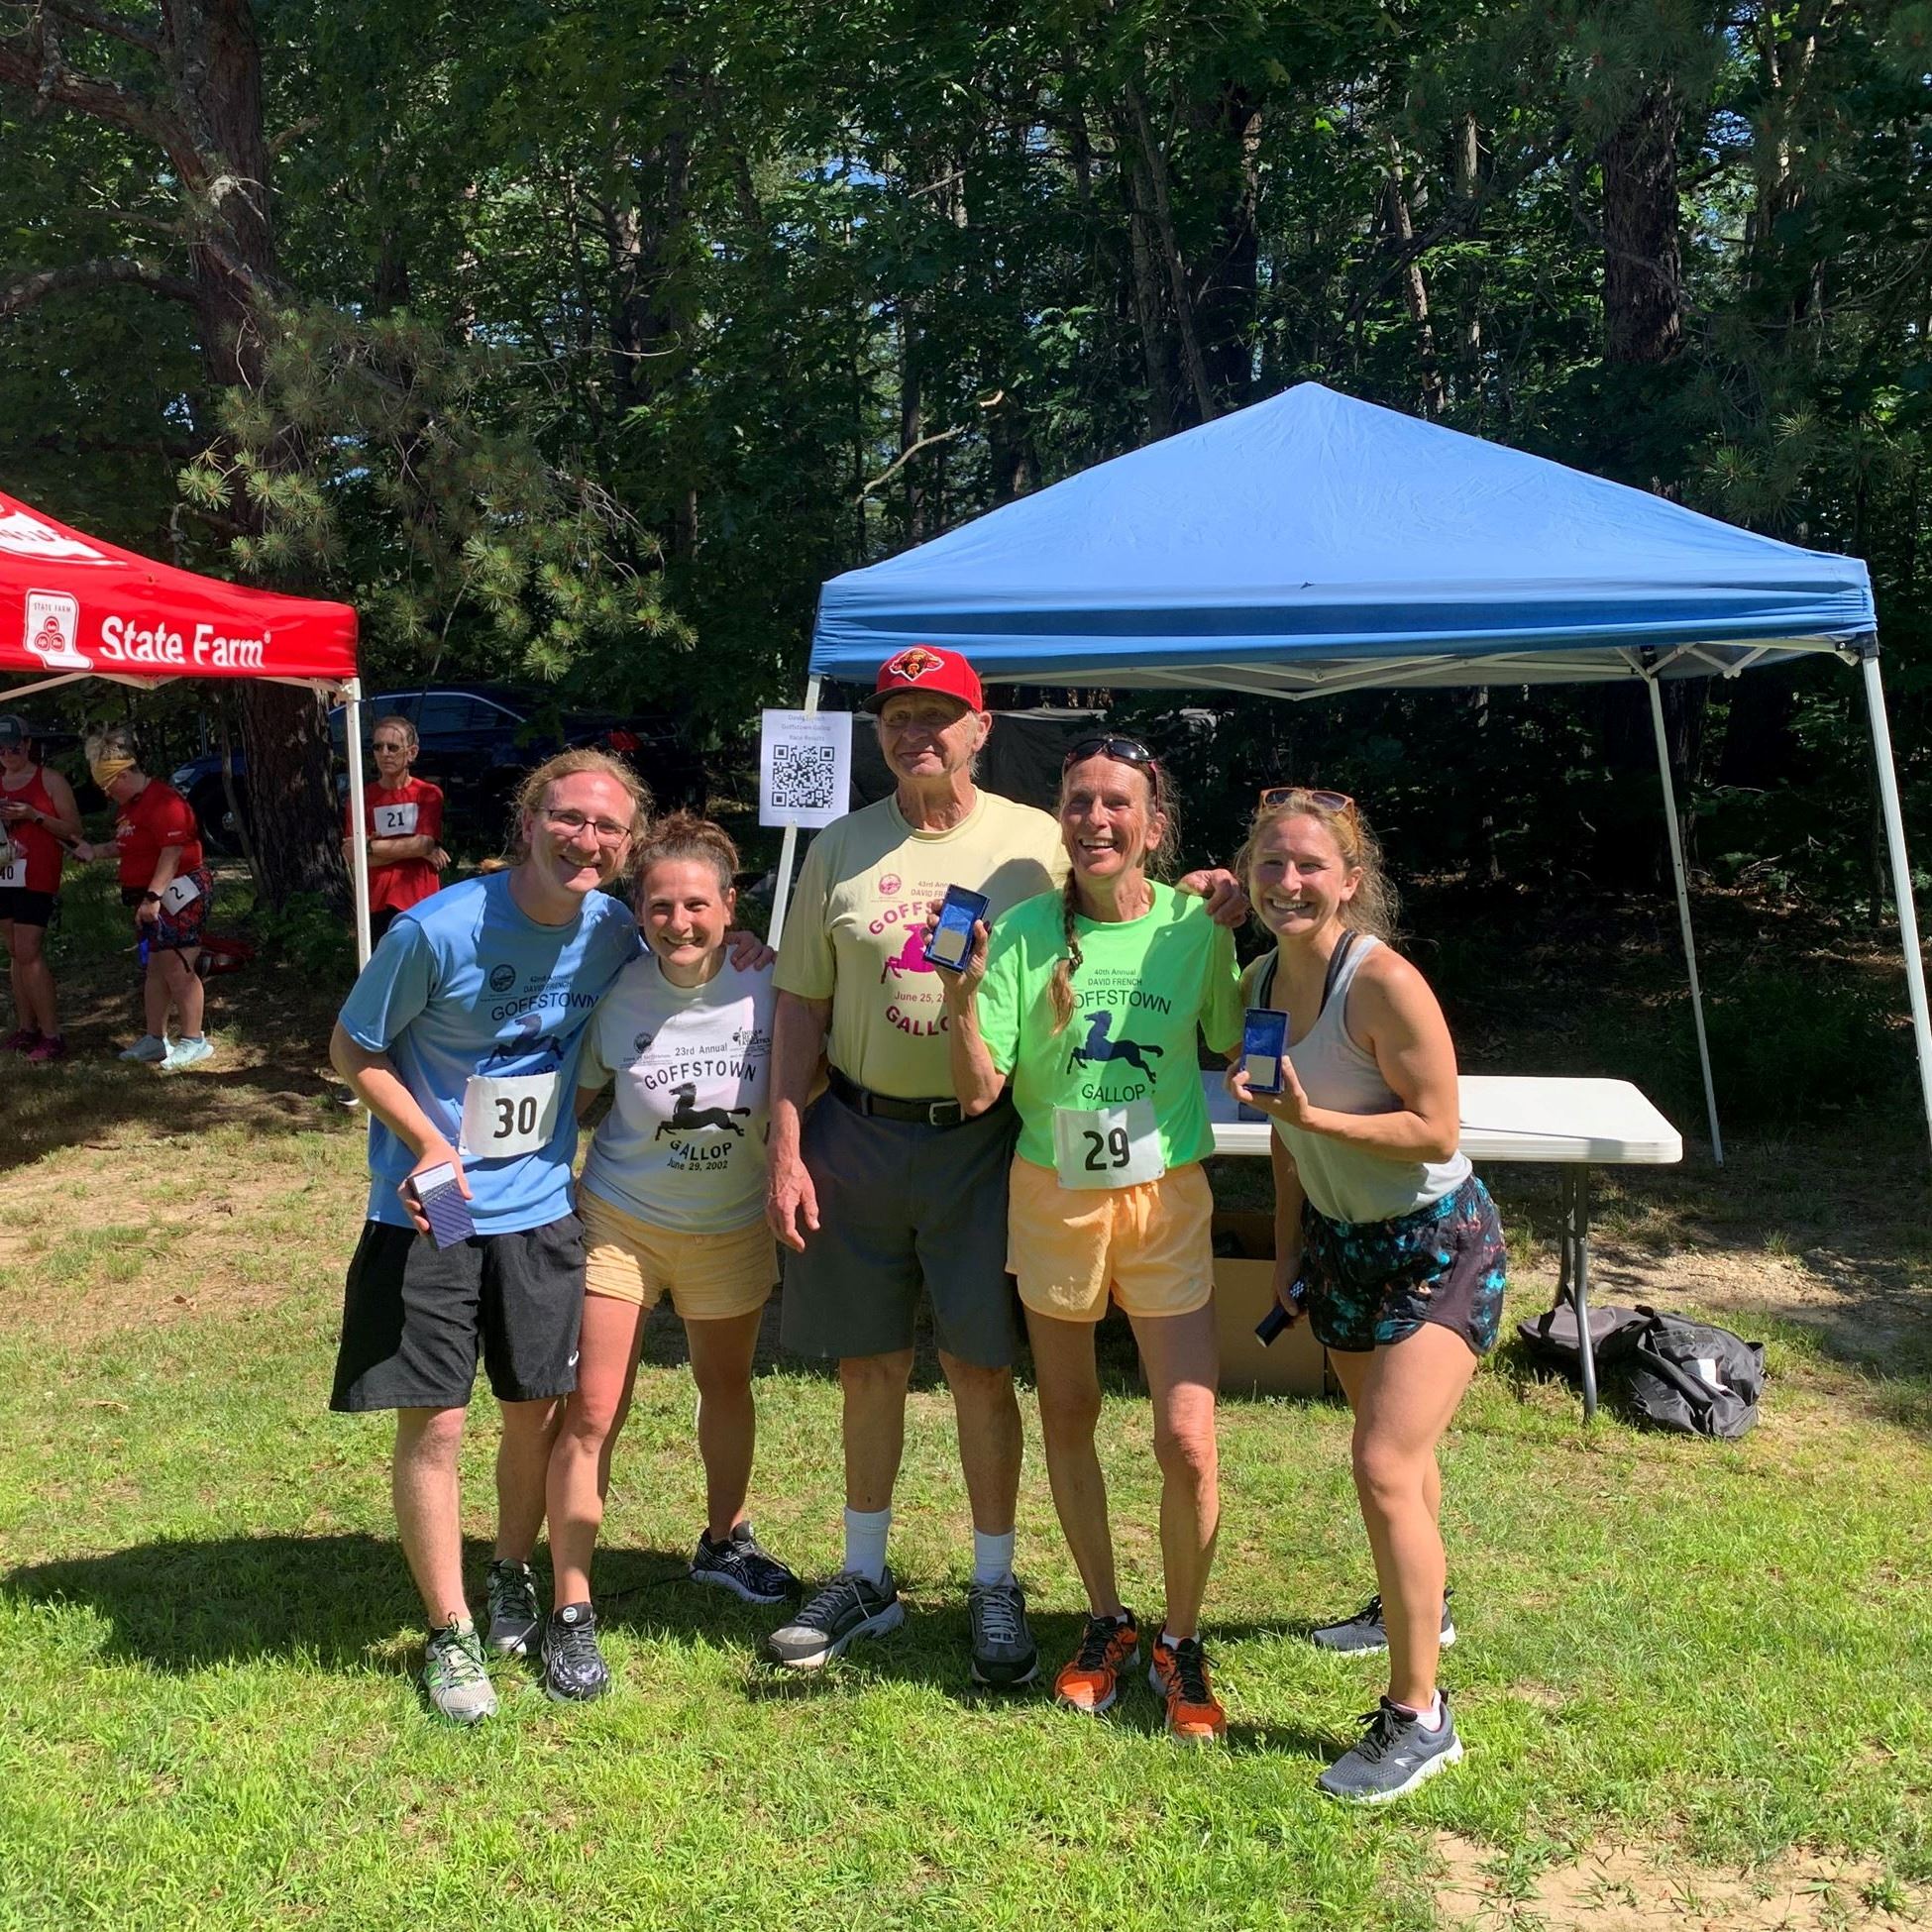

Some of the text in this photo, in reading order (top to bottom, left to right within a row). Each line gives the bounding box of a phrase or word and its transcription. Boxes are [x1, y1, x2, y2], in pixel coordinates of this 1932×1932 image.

[34, 602, 52, 612] STATE
[99, 616, 186, 665] State
[386, 811, 404, 828] 21
[169, 886, 184, 901] 2
[911, 889, 933, 898] DAVID
[491, 992, 599, 1021] GOFFSTOWN
[895, 991, 917, 1002] June
[919, 993, 934, 1004] 25,
[1073, 990, 1172, 1016] OFFSTOWN
[675, 1046, 696, 1057] 23rd
[698, 1042, 728, 1055] Annual
[644, 1060, 757, 1090] GOFFSTOWN
[1081, 1083, 1146, 1103] GALLOP
[493, 1096, 537, 1139] 30
[670, 1139, 732, 1161] GALLOP
[1083, 1127, 1130, 1171] 29
[667, 1157, 728, 1171] June 29, 2002
